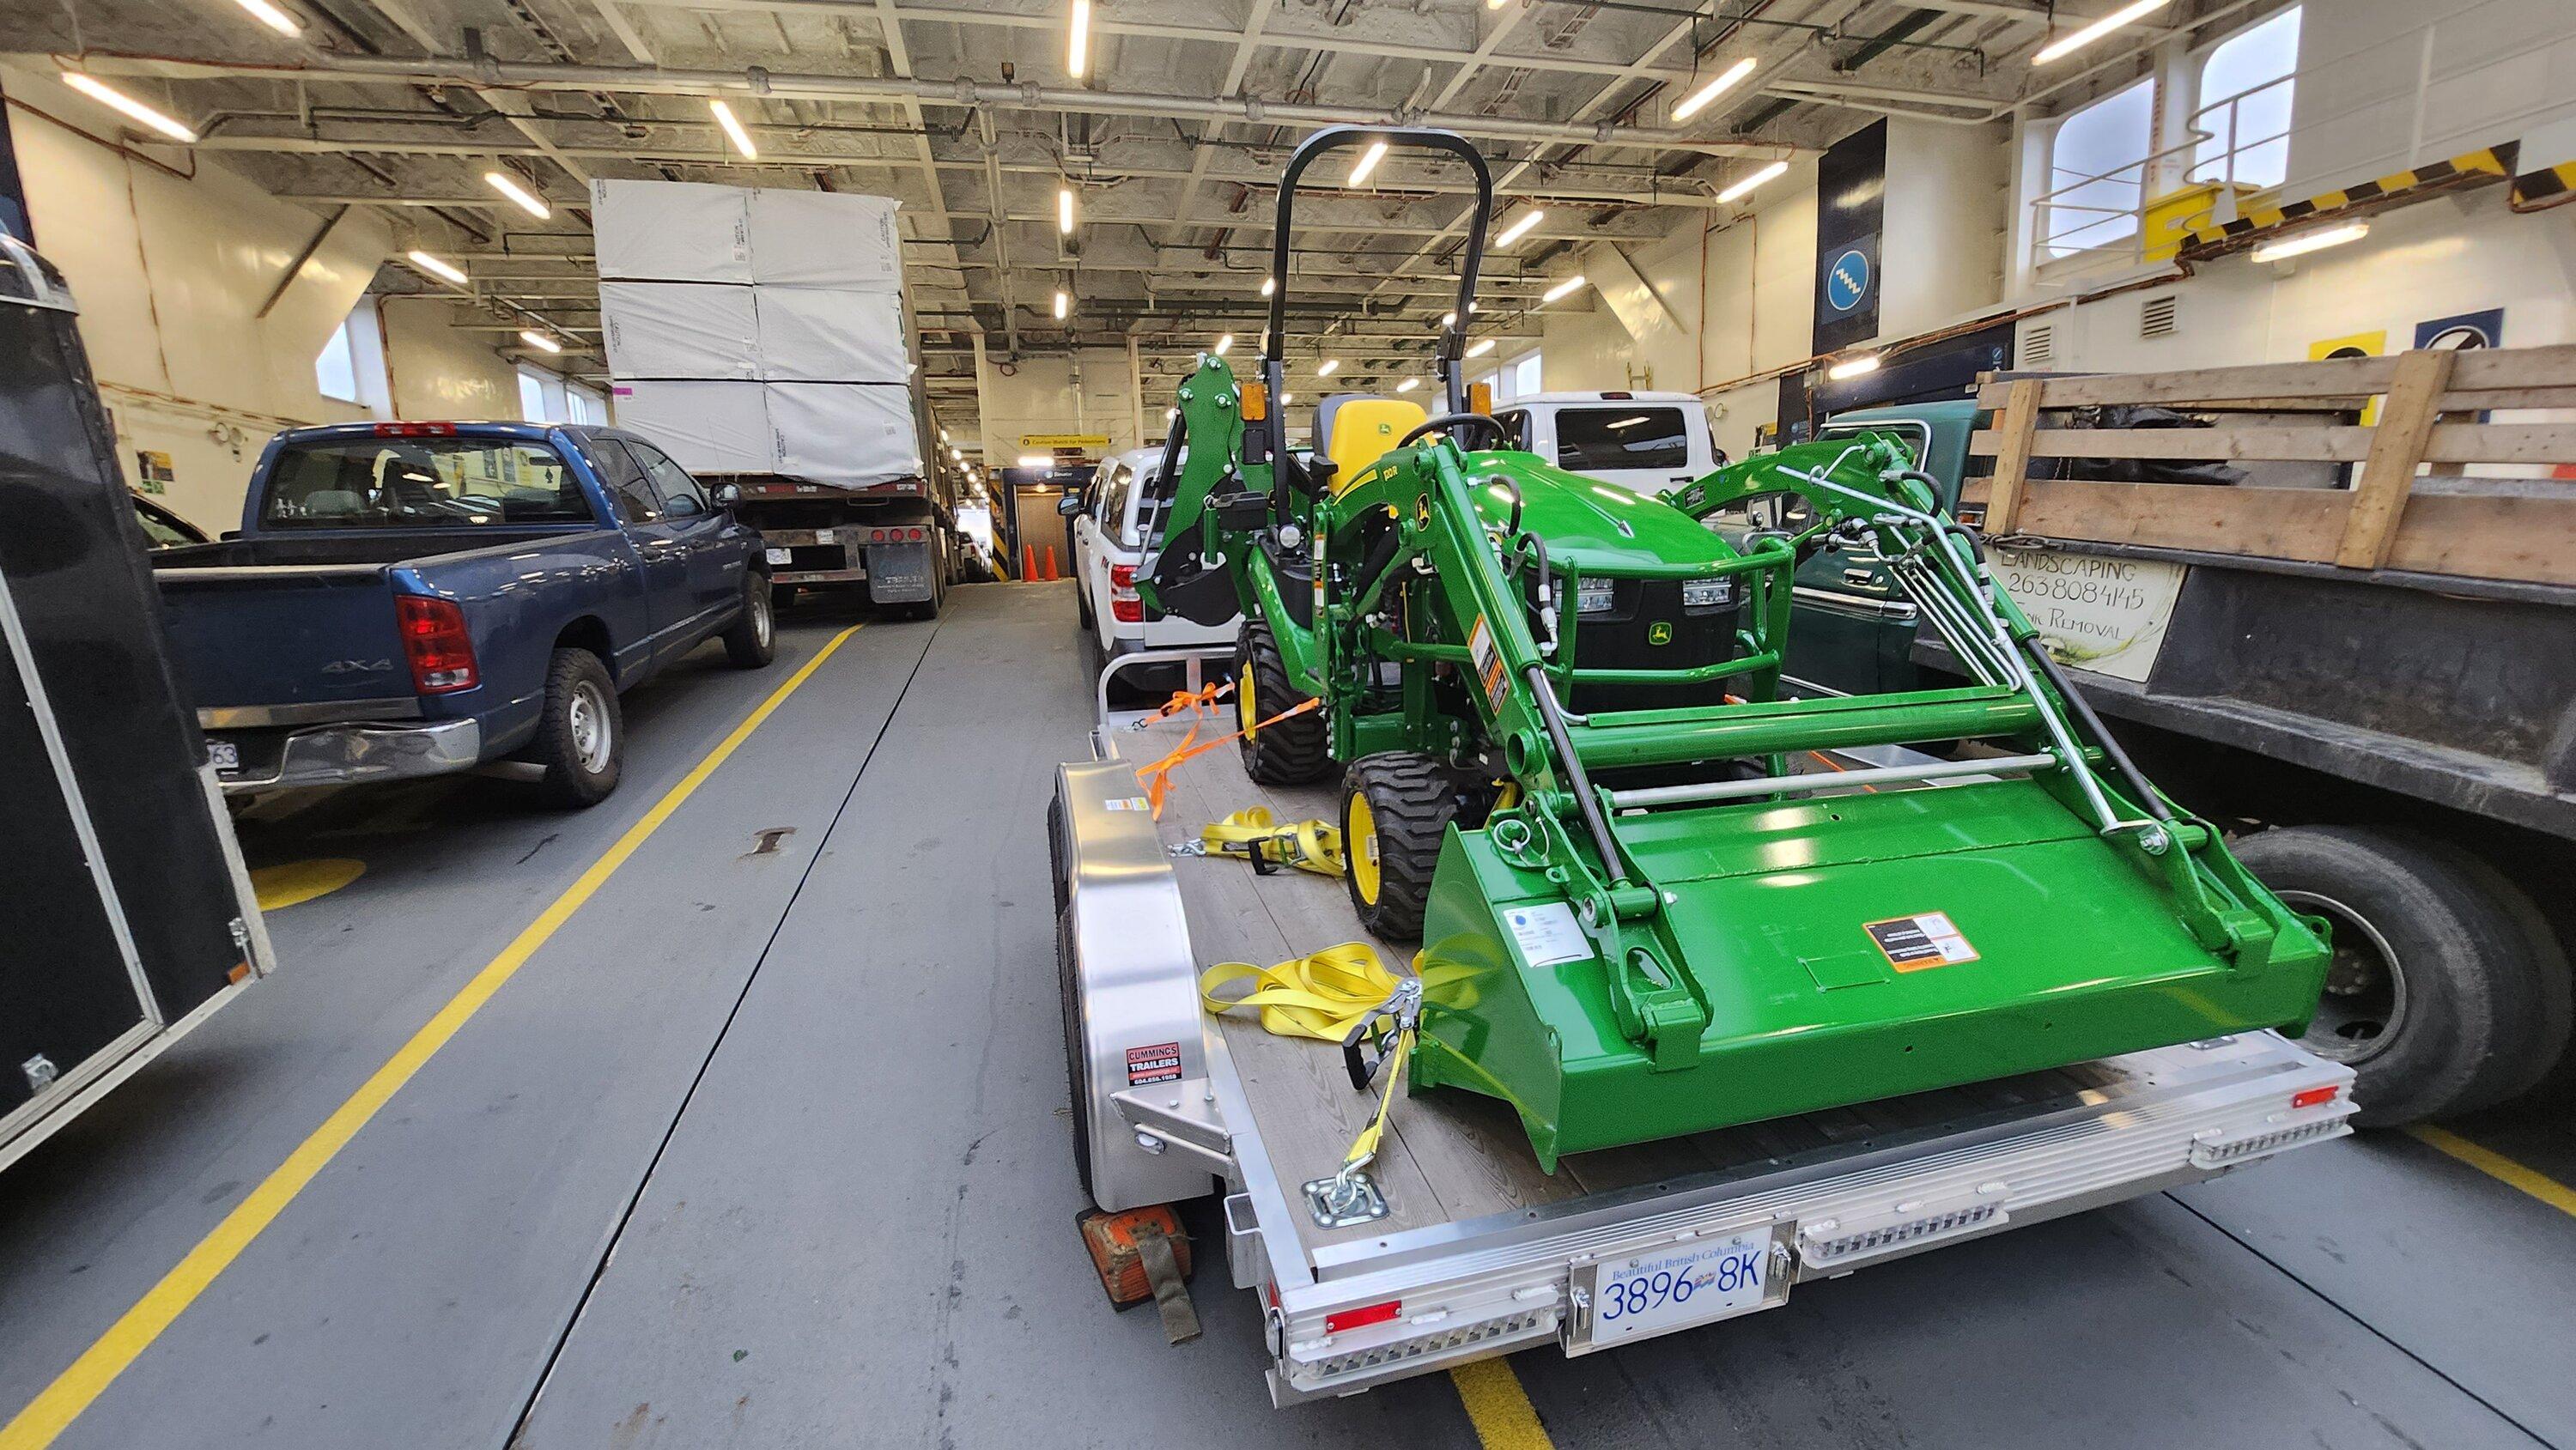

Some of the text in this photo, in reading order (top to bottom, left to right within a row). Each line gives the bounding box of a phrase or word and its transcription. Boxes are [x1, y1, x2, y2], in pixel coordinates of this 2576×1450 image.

[2001, 552, 2136, 581] LANDSCAPING
[2048, 608, 2125, 640] REMOVAL
[1130, 1058, 1178, 1072] TRAILERS
[1613, 1242, 1754, 1281] Beautiful British Columbia
[1602, 1249, 1762, 1320] 3896 8K
